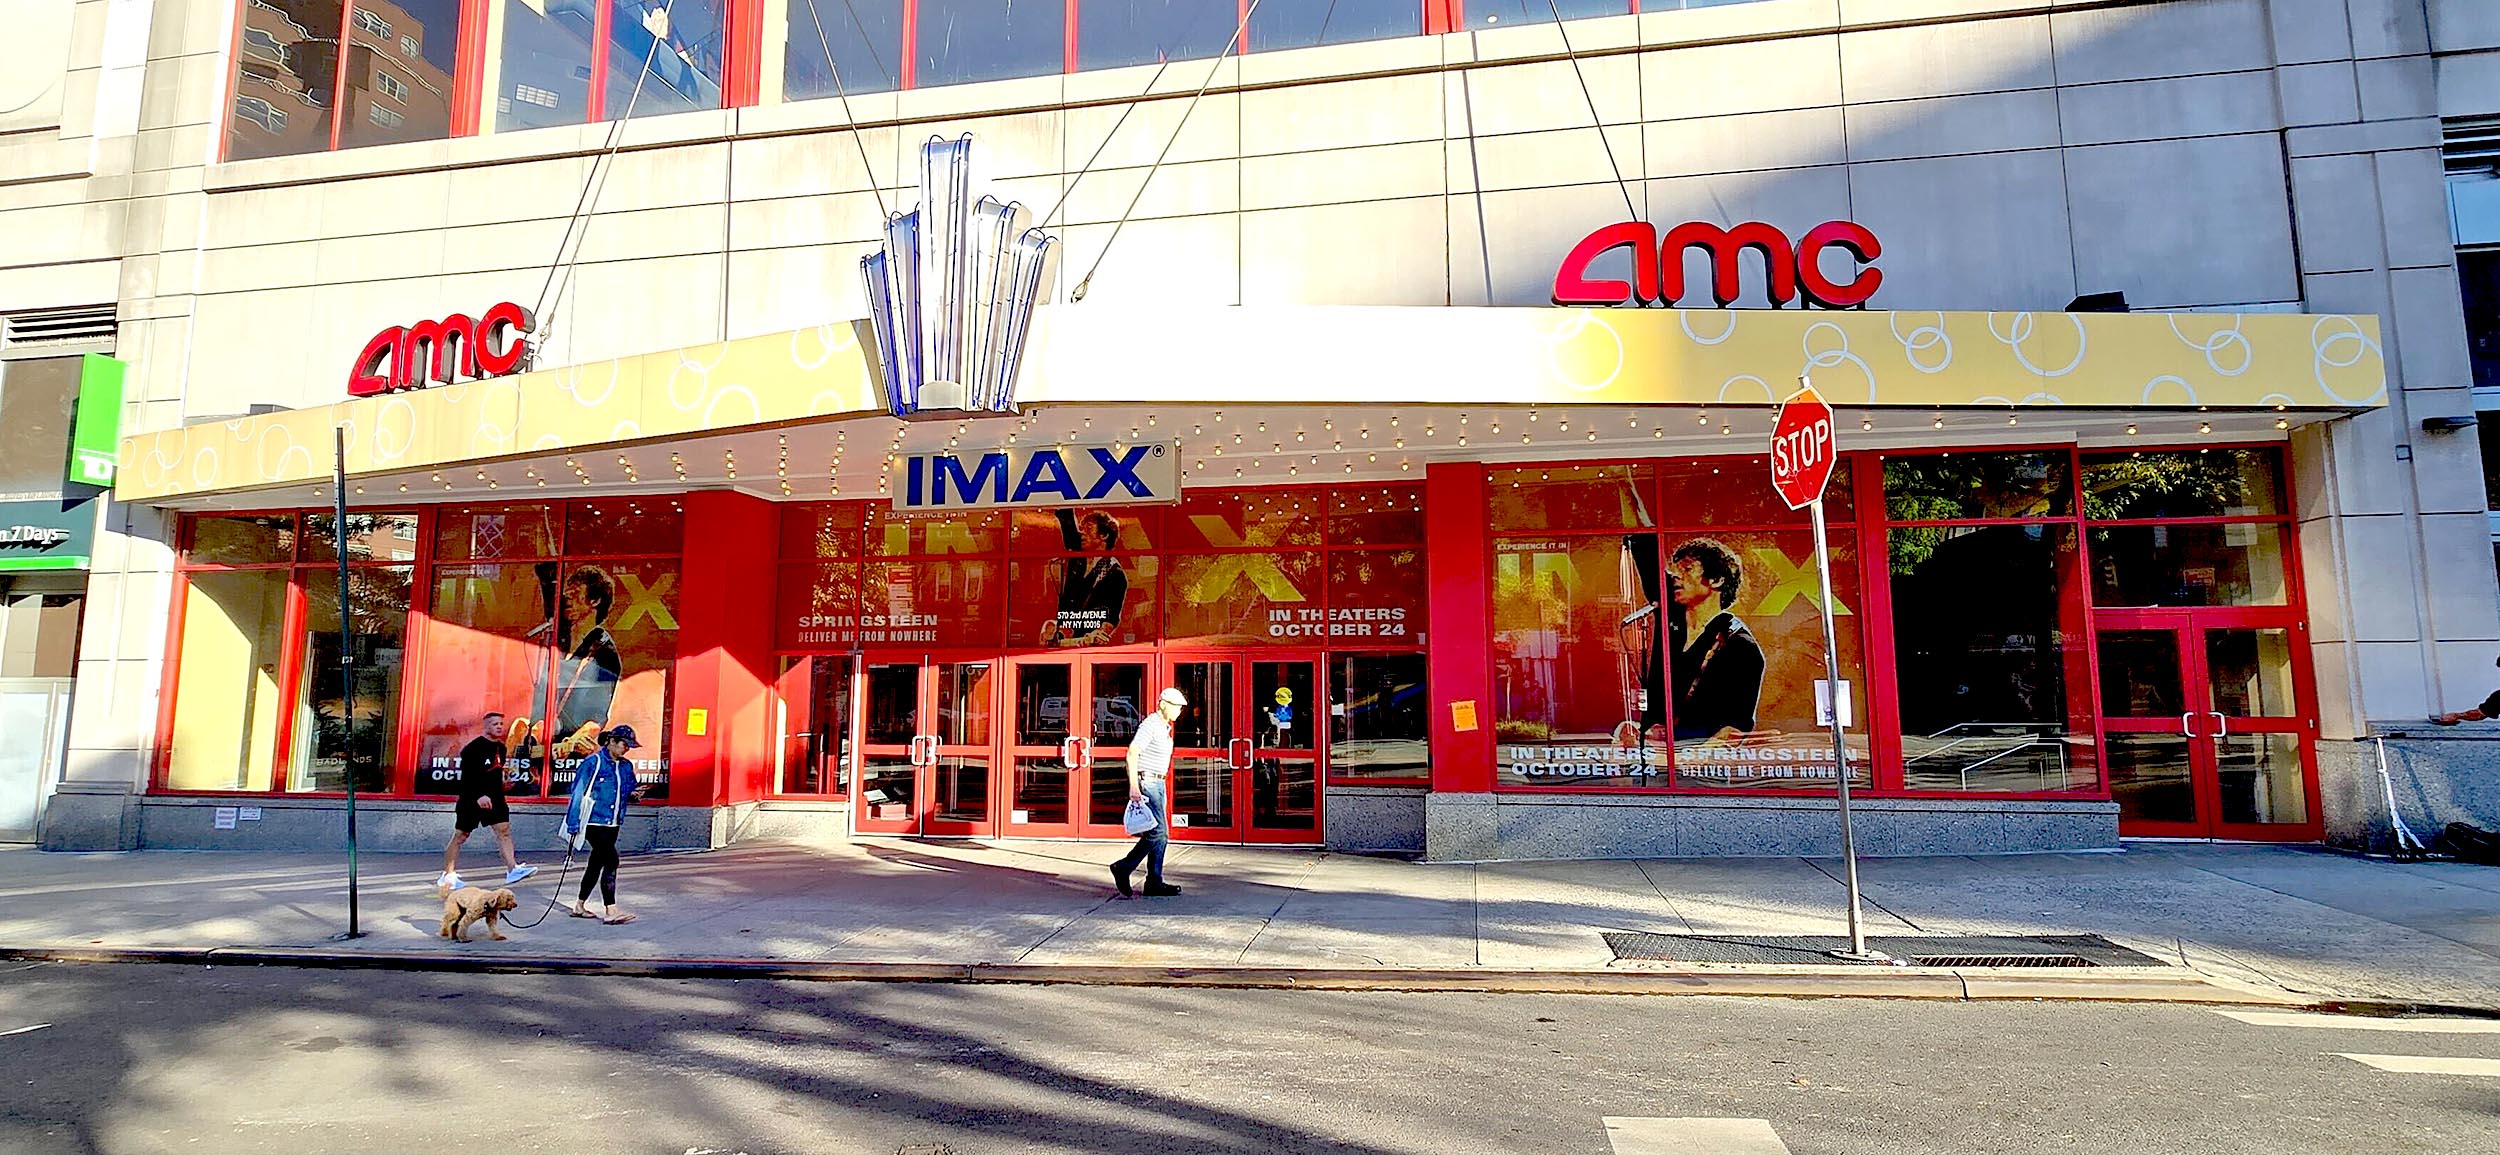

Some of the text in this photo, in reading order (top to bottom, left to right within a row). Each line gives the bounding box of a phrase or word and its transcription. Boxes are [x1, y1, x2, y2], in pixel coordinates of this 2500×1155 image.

[1776, 418, 1829, 477] STOP
[11, 526, 22, 541] 7
[24, 525, 58, 545] Days
[798, 614, 938, 627] SPRINGSTEEN
[1057, 610, 1106, 619] 570 2nd AVENUE
[1269, 608, 1406, 621] IN THEATERS
[1073, 620, 1082, 629] NY
[1269, 623, 1406, 637] OCTOBER 24
[798, 629, 937, 643] DELIVER ME FROM NOWHERE
[1510, 746, 1657, 760] IN THEATERS
[432, 757, 448, 768] IN
[1511, 762, 1658, 777] OCTOBER 24
[636, 772, 668, 784] OWHERE
[1682, 765, 1858, 779] DELIVER ME FROM NOWHRE
